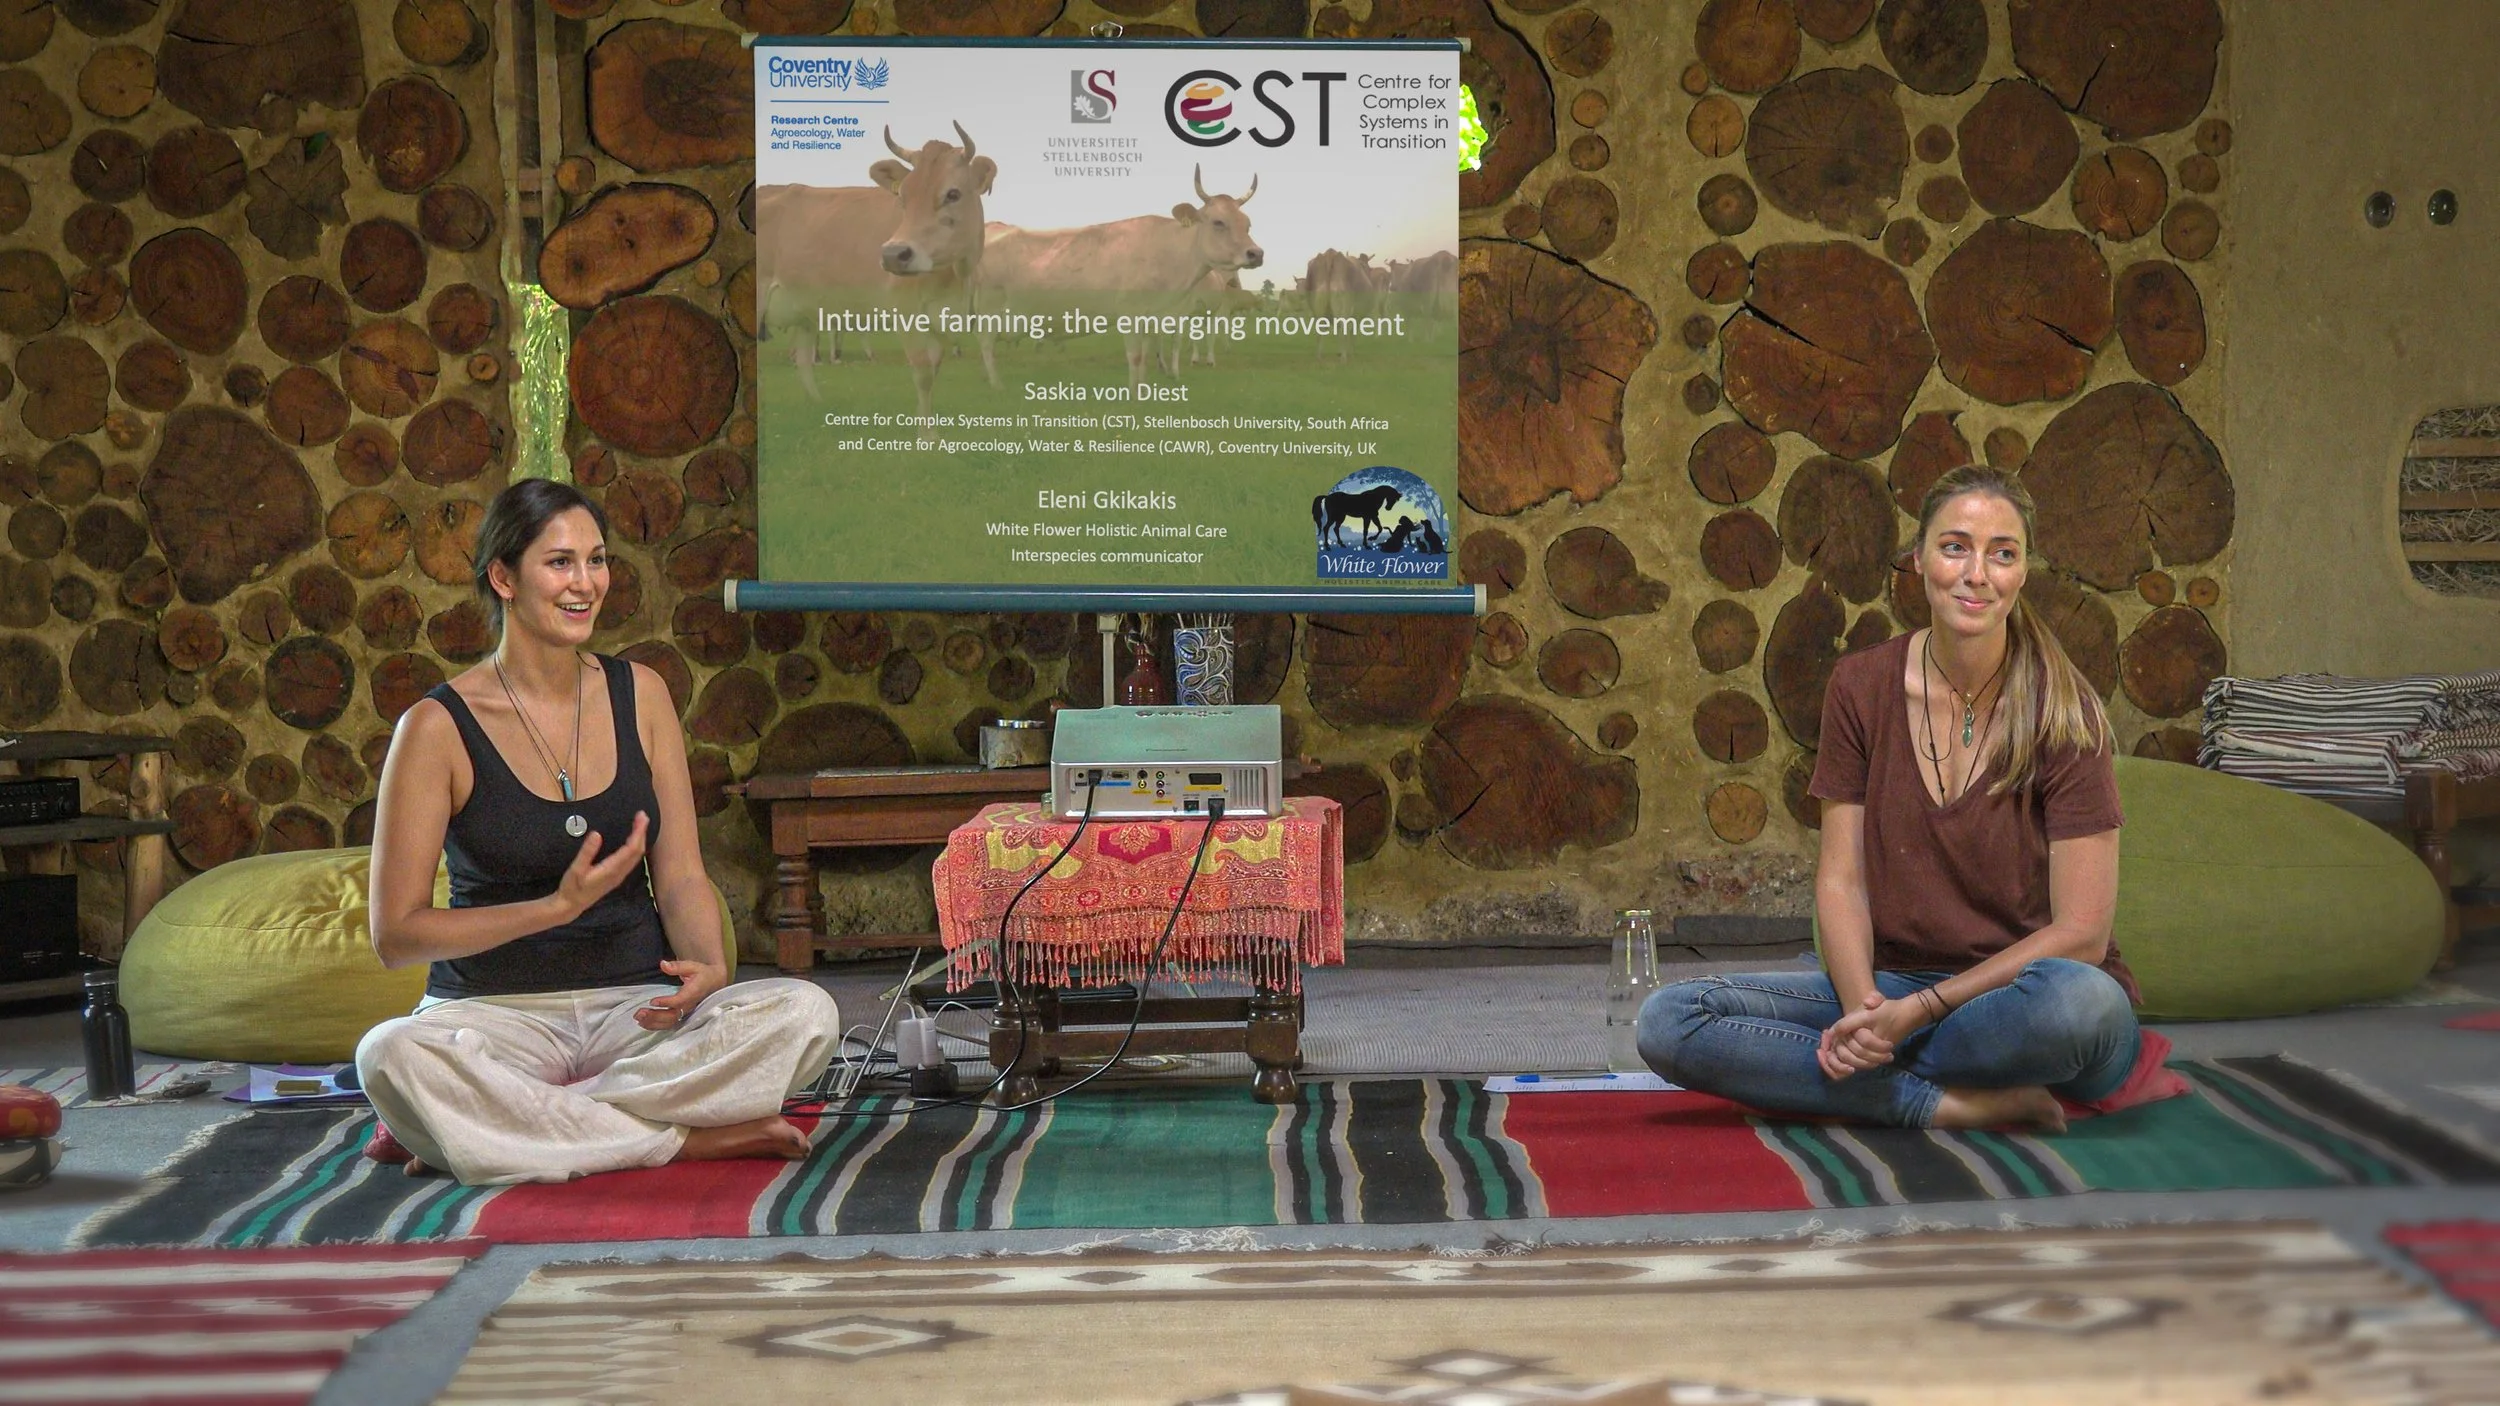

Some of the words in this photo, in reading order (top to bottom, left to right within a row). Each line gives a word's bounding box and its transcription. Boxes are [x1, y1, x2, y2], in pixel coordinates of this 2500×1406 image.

[769, 56, 852, 77] Coventry
[770, 72, 852, 92] University
[1358, 74, 1421, 89] Centre
[1428, 73, 1452, 89] for
[1164, 69, 1347, 148] CST
[1363, 94, 1446, 112] Complex
[771, 116, 820, 125] Research
[823, 116, 858, 125] Centre
[1359, 114, 1428, 132] Systems
[1434, 115, 1448, 130] in
[770, 128, 834, 138] Agroecology,
[836, 128, 866, 138] Water
[1362, 134, 1446, 149] Transition
[771, 140, 790, 150] and
[792, 140, 842, 150] Resilience
[1048, 137, 1138, 148] UNIVERSITEIT
[1043, 152, 1143, 162] STELLENBOSCH
[1054, 166, 1132, 176] UNIVERSITY
[818, 308, 930, 332] Intuitive
[939, 306, 1054, 339] farming:
[1063, 308, 1108, 334] the
[1116, 310, 1246, 340] emerging
[1255, 314, 1404, 336] movement
[1024, 382, 1086, 400] Saskia
[1093, 387, 1130, 401] von
[1136, 384, 1188, 402] Diest
[825, 413, 870, 426] Centre
[873, 413, 892, 426] for
[896, 414, 954, 428] Complex
[958, 414, 1012, 429] Systems
[1016, 414, 1028, 427] in
[1032, 415, 1098, 428] Transition
[1102, 415, 1140, 430] (CST),
[1144, 416, 1229, 429] Stellenbosch
[1234, 416, 1302, 432] University,
[1306, 417, 1346, 430] South
[1350, 417, 1389, 430] Africa
[838, 438, 863, 450] and
[867, 438, 912, 450] Centre
[916, 438, 934, 451] for
[938, 439, 1024, 454] Agroecology,
[1028, 440, 1070, 452] Water
[1073, 440, 1084, 452] &
[1089, 440, 1154, 453] Resilience
[1159, 440, 1214, 456] (CAWR),
[1218, 441, 1278, 456] Coventry
[1283, 442, 1353, 457] University,
[1358, 442, 1376, 455] UK
[1038, 490, 1086, 509] Eleni
[1094, 491, 1176, 510] Gkikakis
[986, 522, 1029, 536] White
[1034, 522, 1082, 536] Flower
[1086, 524, 1138, 537] Holistic
[1141, 524, 1190, 538] Animal
[1196, 525, 1227, 538] Care
[1012, 549, 1096, 564] Interspecies
[1100, 550, 1204, 564] communicator
[1320, 554, 1375, 574] White
[1378, 556, 1444, 578] Flower
